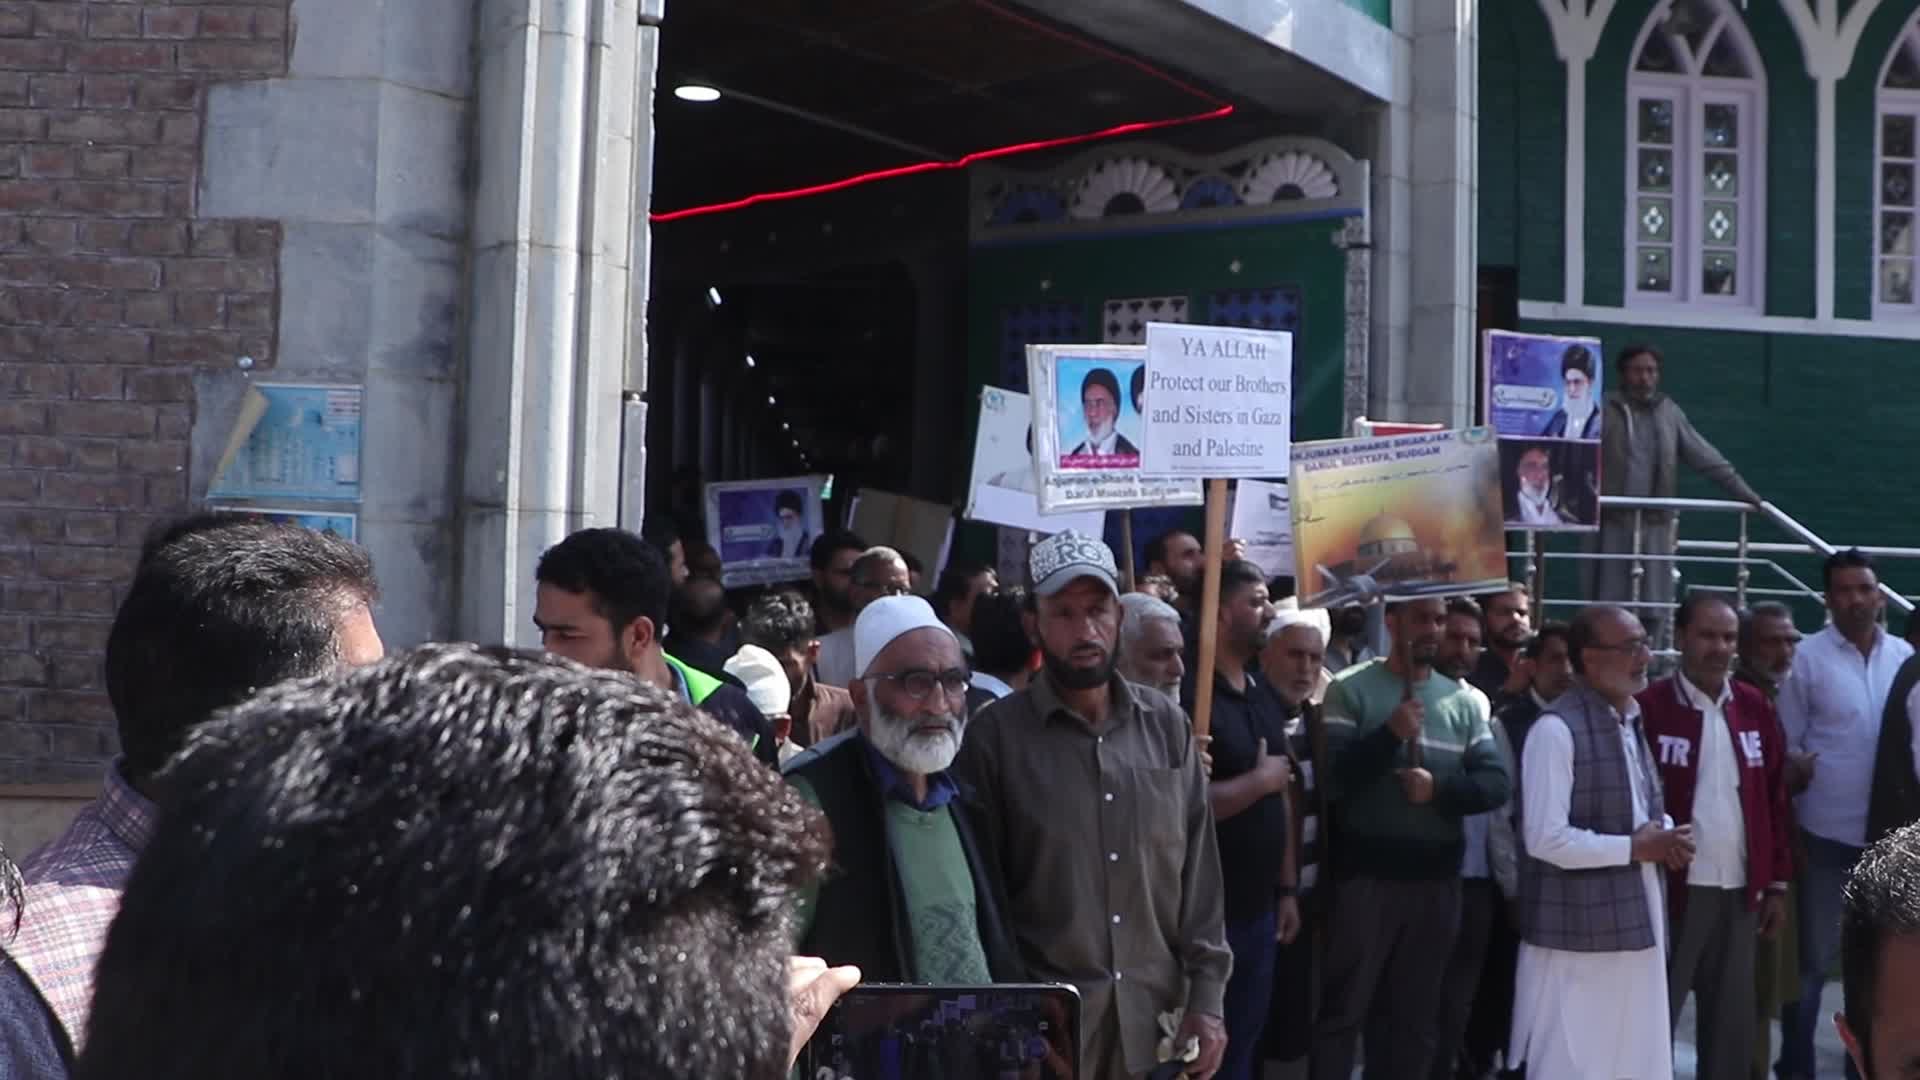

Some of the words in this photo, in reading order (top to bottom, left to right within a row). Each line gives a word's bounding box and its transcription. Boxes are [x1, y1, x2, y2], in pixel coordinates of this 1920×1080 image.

[1181, 337, 1207, 357] YA
[1211, 339, 1267, 360] ALLAH
[1150, 370, 1205, 391] Protect
[1208, 377, 1233, 393] our
[1235, 374, 1287, 393] Brothers
[1152, 404, 1181, 423] and
[1184, 404, 1233, 424] Sisters
[1236, 408, 1249, 425] in
[1251, 407, 1282, 425] Gaza
[1172, 438, 1201, 457] and
[1206, 438, 1264, 457] Palestine
[1396, 446, 1440, 460] BUDGAM
[1657, 734, 1691, 767] TR
